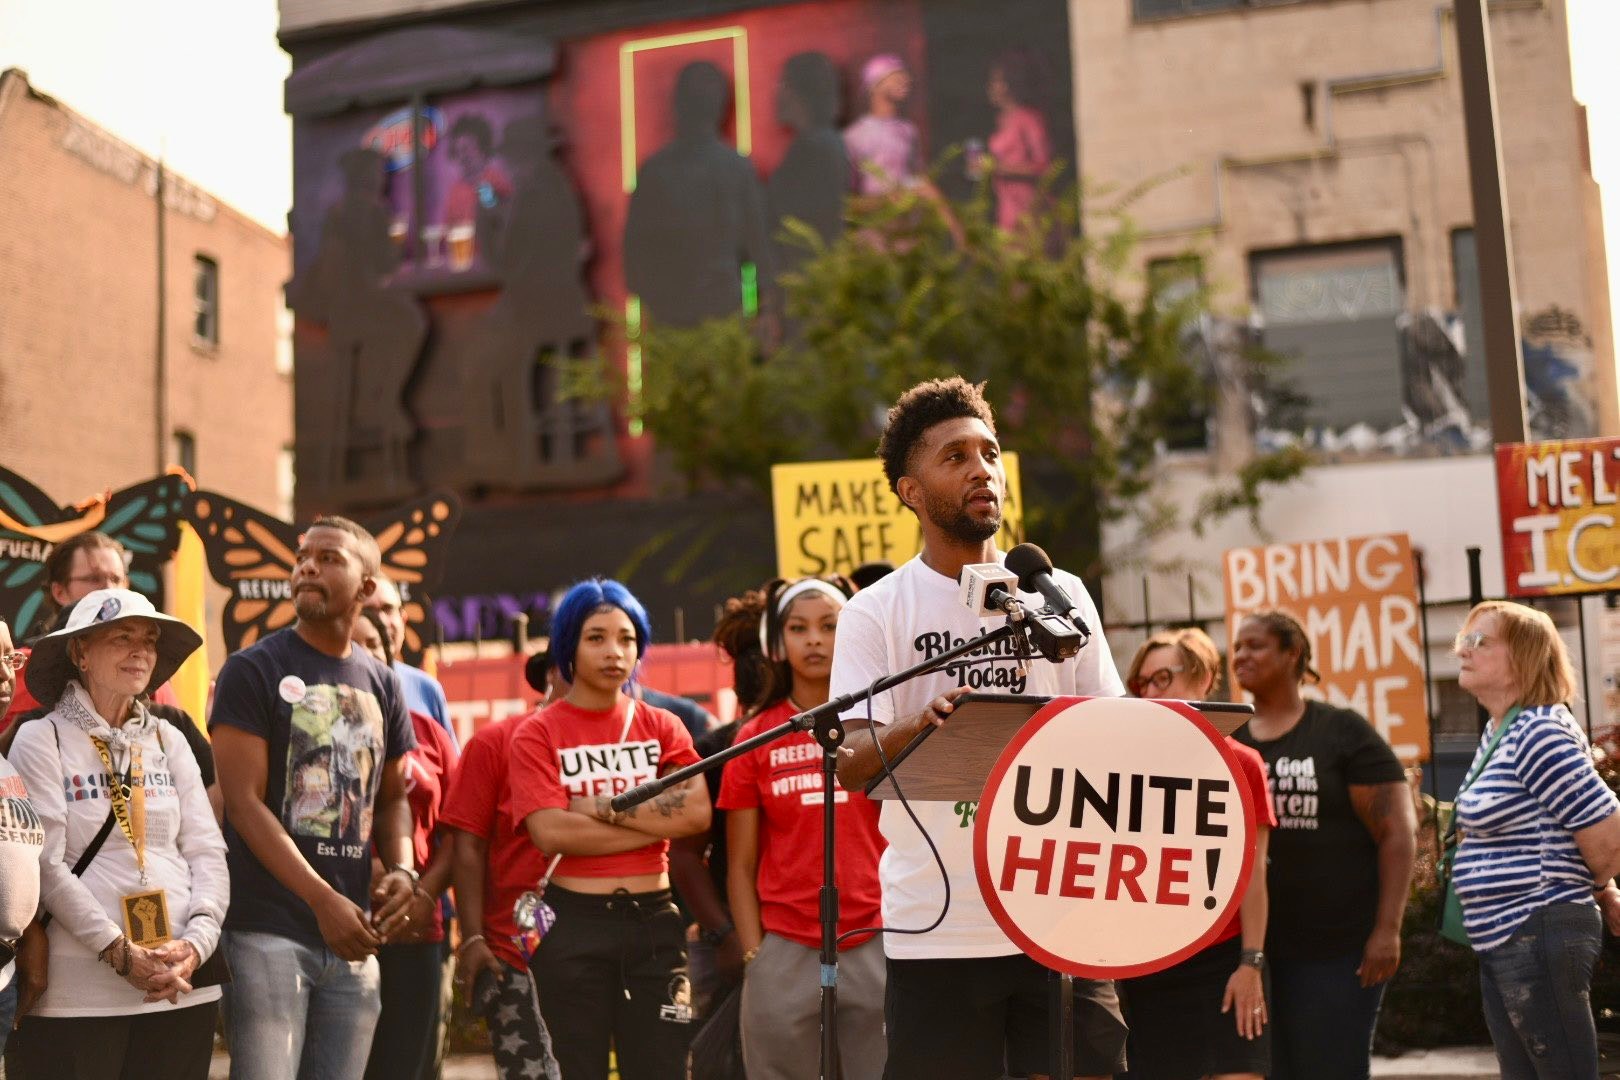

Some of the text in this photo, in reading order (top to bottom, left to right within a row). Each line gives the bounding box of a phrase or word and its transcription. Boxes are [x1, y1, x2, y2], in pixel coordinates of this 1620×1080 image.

[795, 479, 888, 519] MAKE
[799, 522, 895, 576] SAFE
[1228, 535, 1404, 609] BRING
[946, 660, 1027, 694] Today
[560, 744, 659, 776] UNITE
[1275, 756, 1316, 778] God
[771, 773, 823, 797] VOTING
[1013, 765, 1229, 837] UNITE
[317, 842, 338, 857] Est.
[1000, 835, 1221, 911] HERE!
